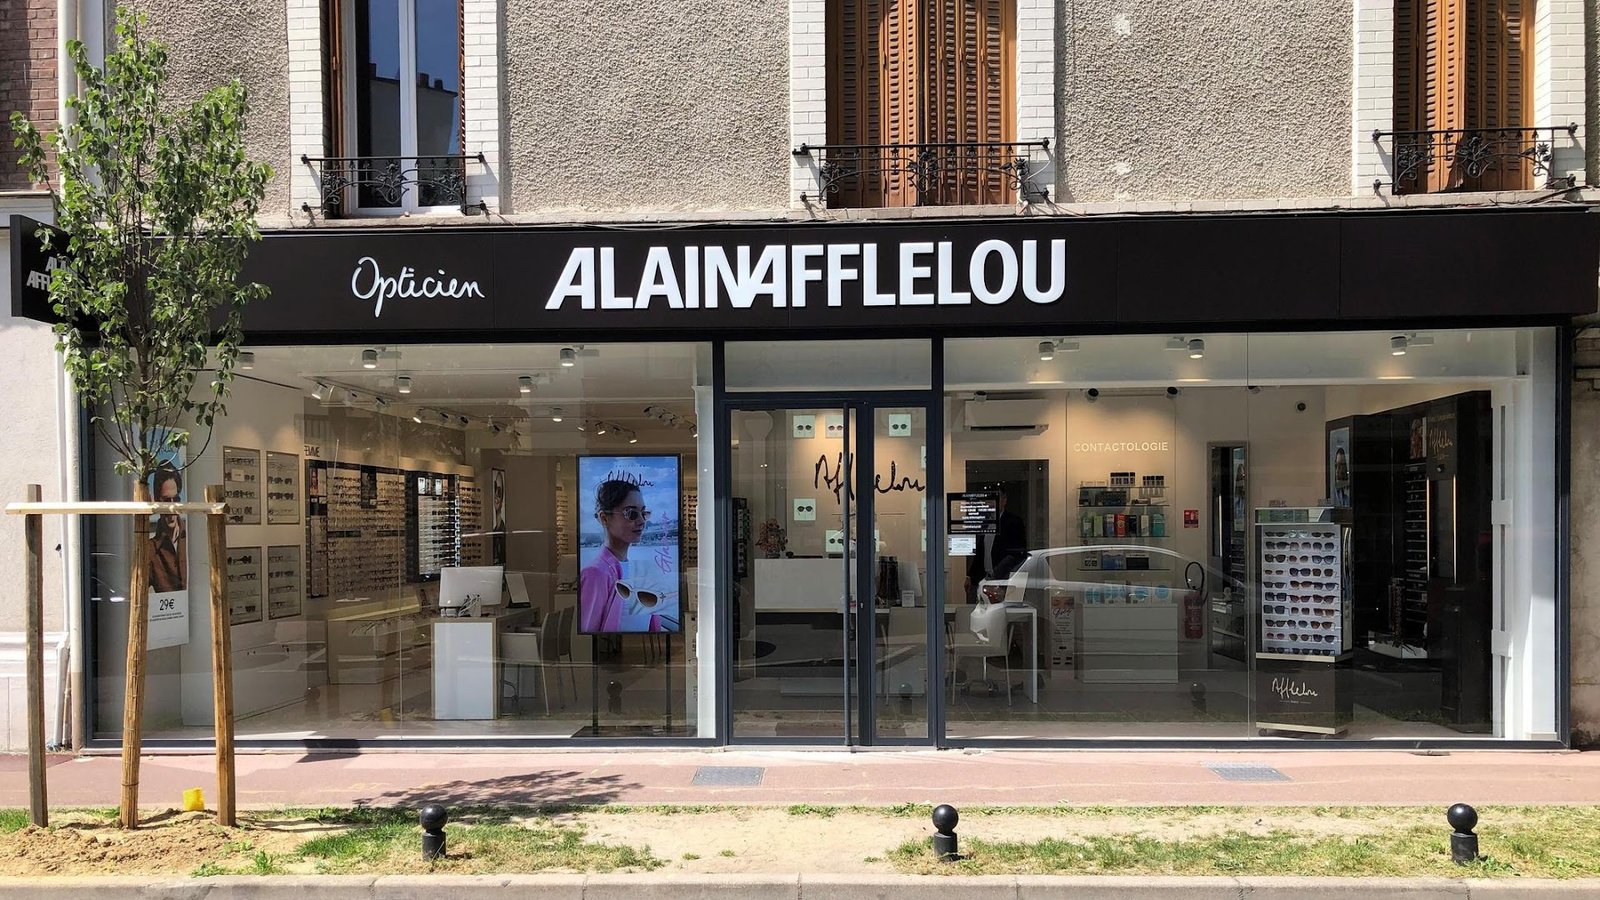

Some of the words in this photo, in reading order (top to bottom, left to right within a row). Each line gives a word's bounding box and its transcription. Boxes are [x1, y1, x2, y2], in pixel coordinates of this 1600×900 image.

[351, 256, 486, 318] Opticien
[1073, 442, 1169, 453] CONTACTOLOGIE
[159, 598, 176, 611] 29€
